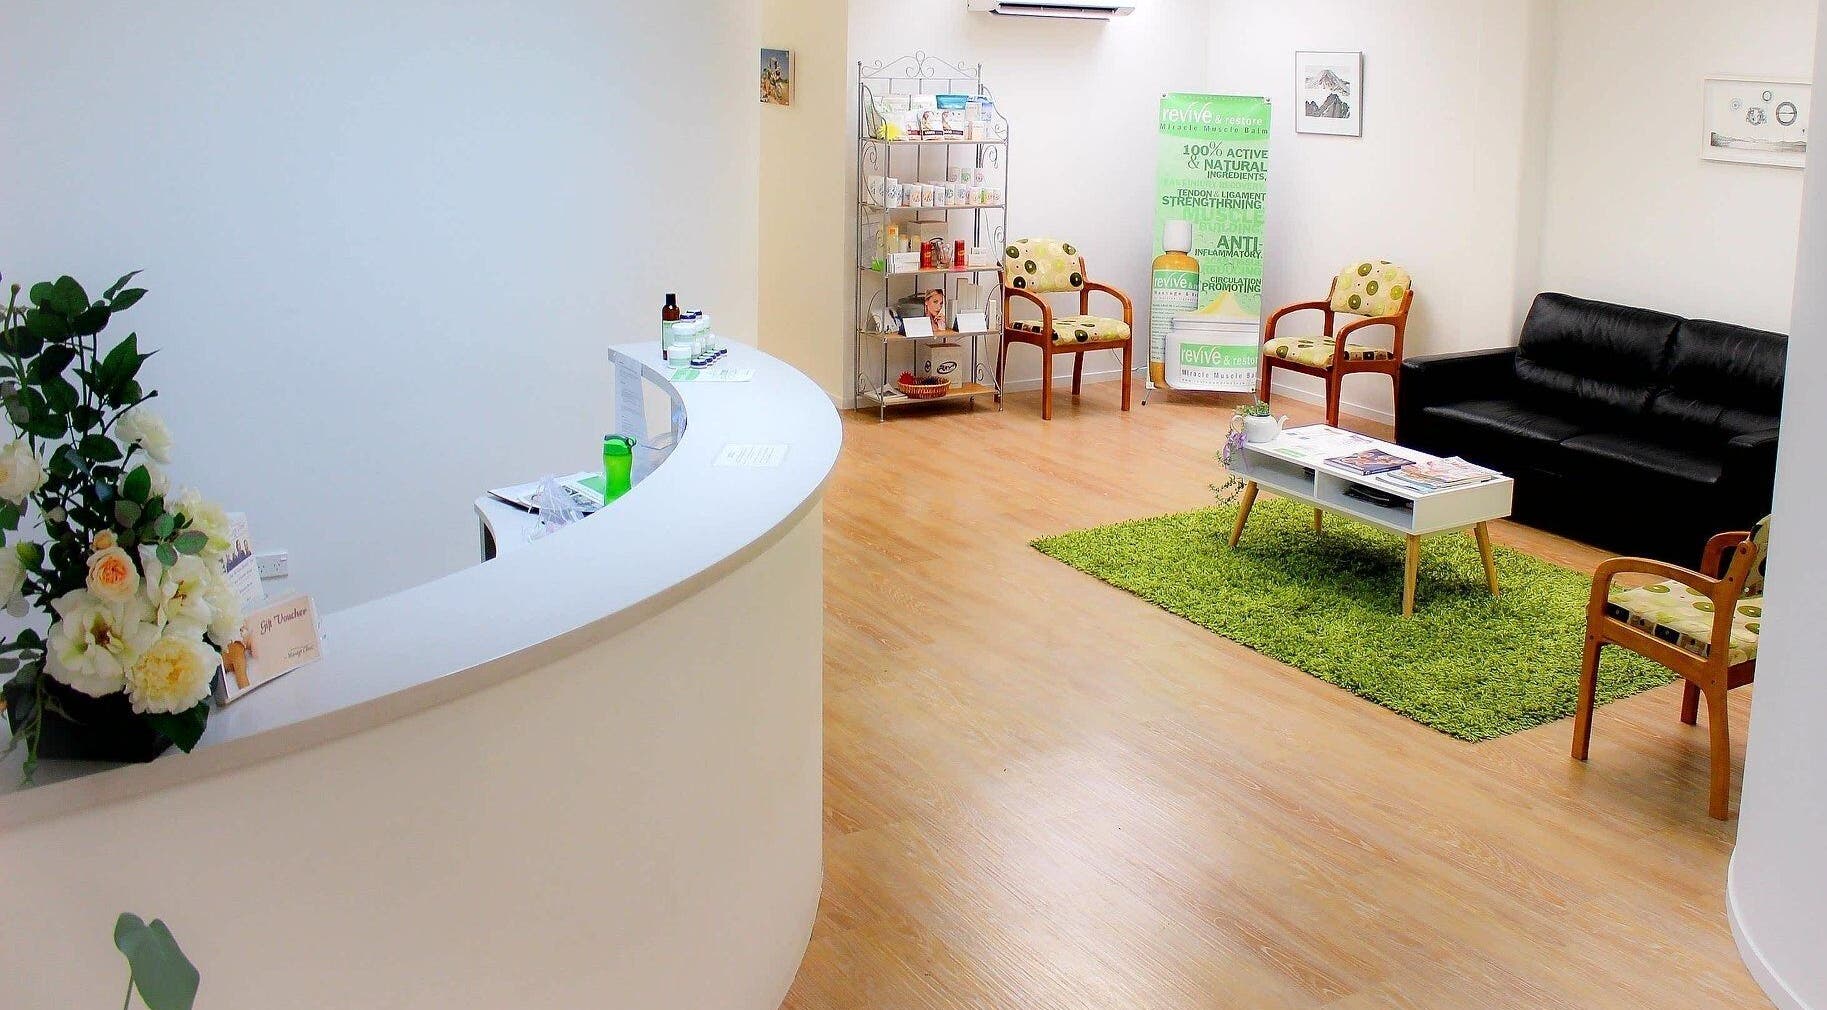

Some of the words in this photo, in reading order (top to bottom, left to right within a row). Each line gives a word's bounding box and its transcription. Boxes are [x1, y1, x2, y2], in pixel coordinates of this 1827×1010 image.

[1162, 101, 1213, 123] revive
[1215, 115, 1221, 123] &
[1225, 116, 1264, 126] restore
[1160, 123, 1198, 131] Miracle
[1203, 125, 1239, 133] Muscle
[1244, 127, 1269, 135] Balm
[1183, 140, 1223, 157] 100%
[1226, 148, 1269, 160] ACTIVE
[1187, 154, 1200, 170] &
[1204, 159, 1268, 173] NATURAL
[1178, 188, 1214, 199] TENDON
[1221, 191, 1267, 202] LIGAMENT
[1217, 235, 1263, 251] ANTI-
[1154, 272, 1187, 289] revive
[1202, 282, 1261, 293] PROMOTING
[1210, 276, 1262, 286] CIRCULATION
[1181, 346, 1220, 365] revive
[1224, 355, 1230, 366] &
[1181, 369, 1209, 378] Miracle
[260, 618, 272, 635] Gift
[273, 608, 307, 624] Voucher
